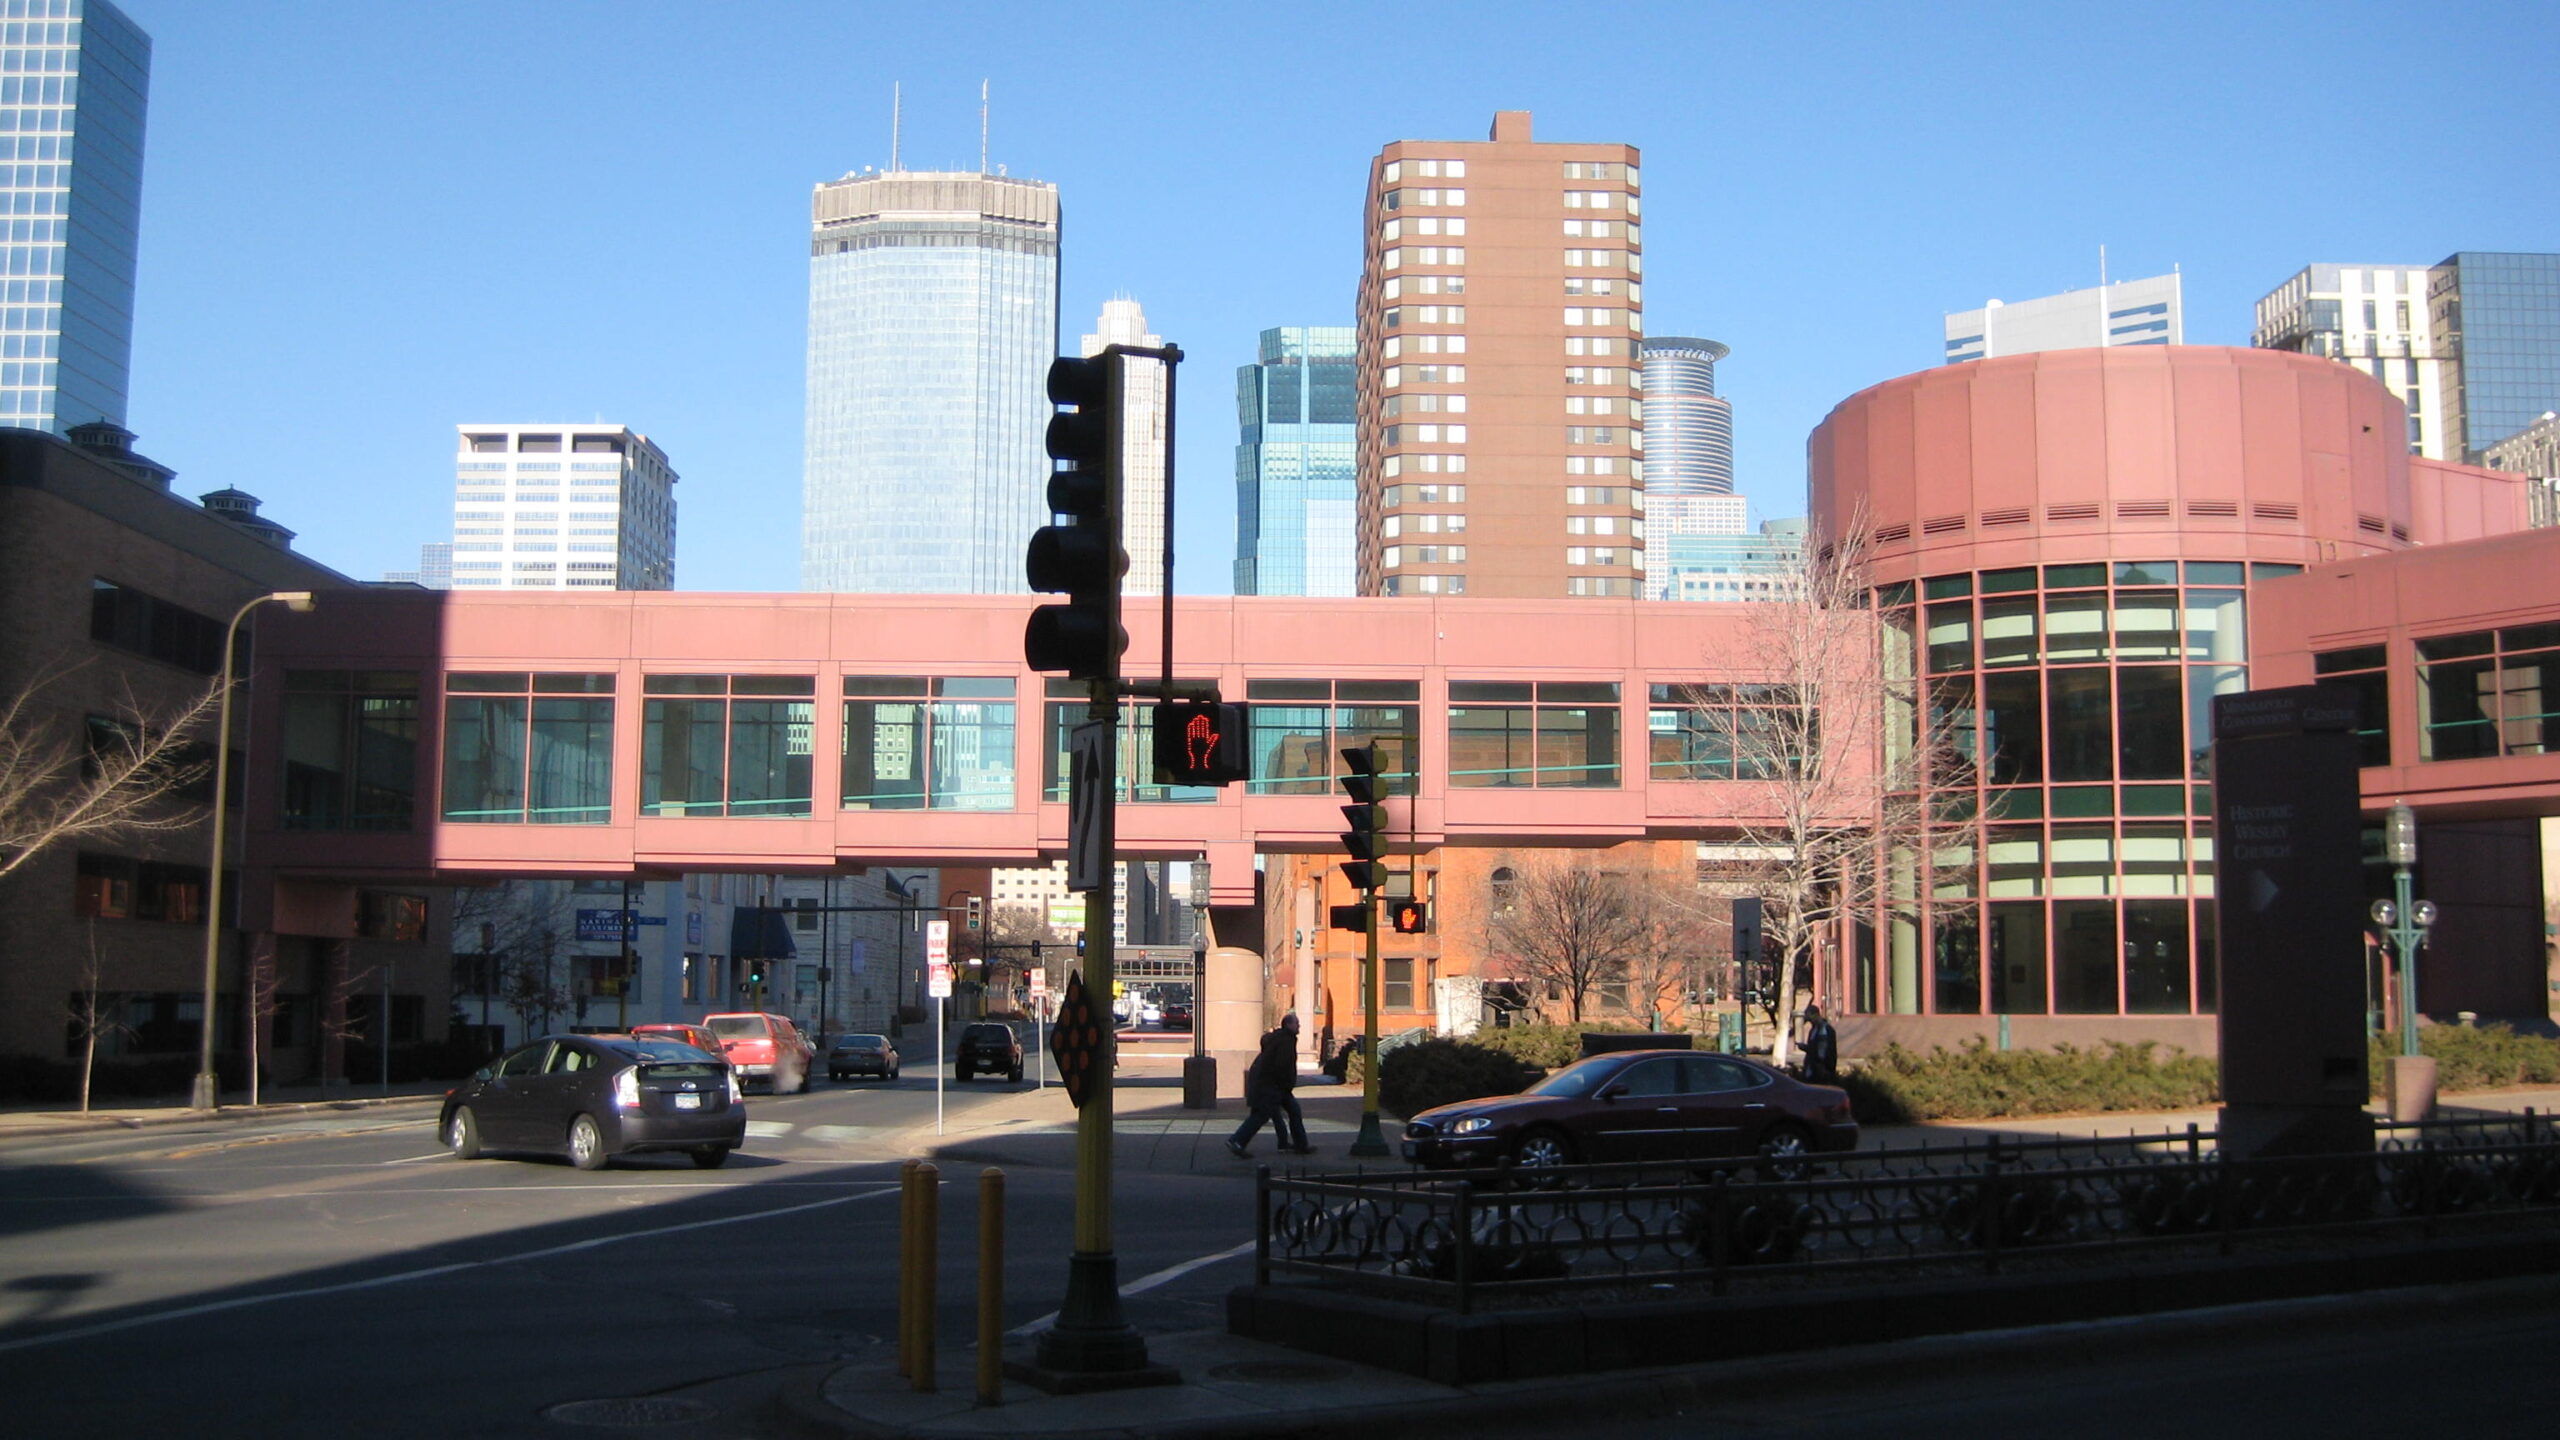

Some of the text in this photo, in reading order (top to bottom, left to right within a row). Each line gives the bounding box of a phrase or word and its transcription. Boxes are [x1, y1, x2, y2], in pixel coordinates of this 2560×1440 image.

[2222, 697, 2294, 713] MINNEAPOLIS
[2221, 706, 2355, 729] CONVENTION CENTER
[2231, 804, 2294, 821] HISTORIC
[2234, 823, 2289, 839] WESLEY
[2233, 843, 2291, 860] CHURCH
